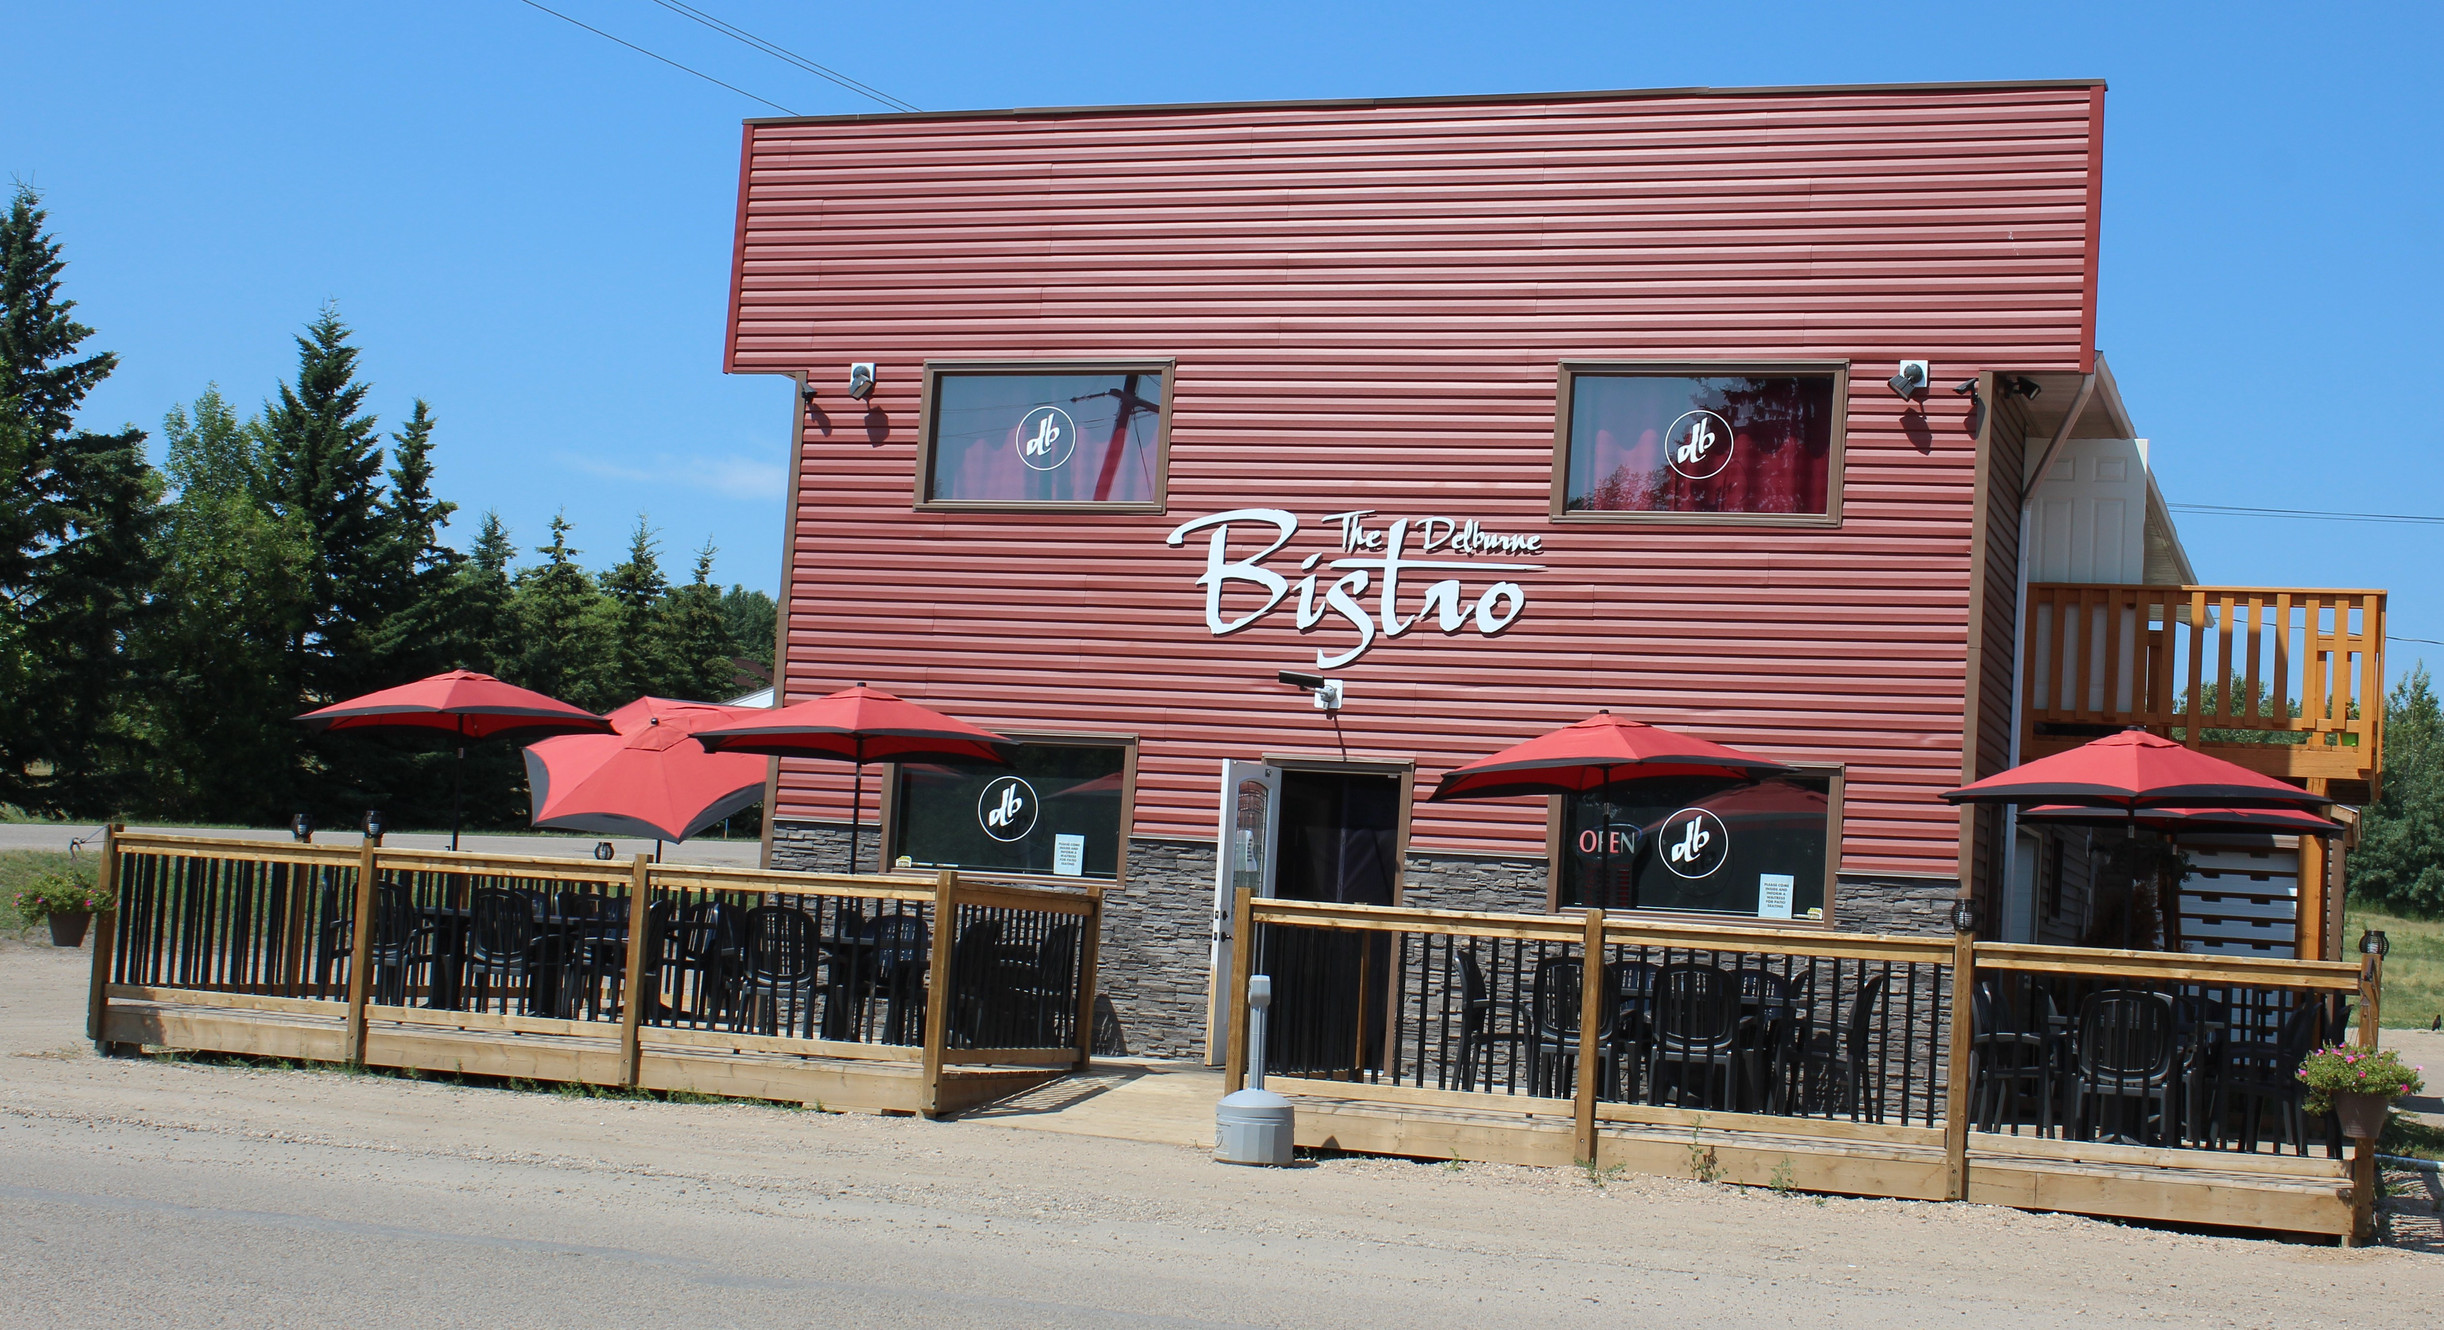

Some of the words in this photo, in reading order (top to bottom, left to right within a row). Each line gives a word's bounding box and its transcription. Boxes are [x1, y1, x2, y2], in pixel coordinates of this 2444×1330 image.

[1026, 412, 1060, 456] db
[1677, 417, 1716, 464] db
[1321, 509, 1383, 552] The
[1414, 515, 1543, 552] Delburne
[1165, 508, 1547, 670] Bistro
[988, 782, 1023, 827] db
[1671, 815, 1710, 863] db
